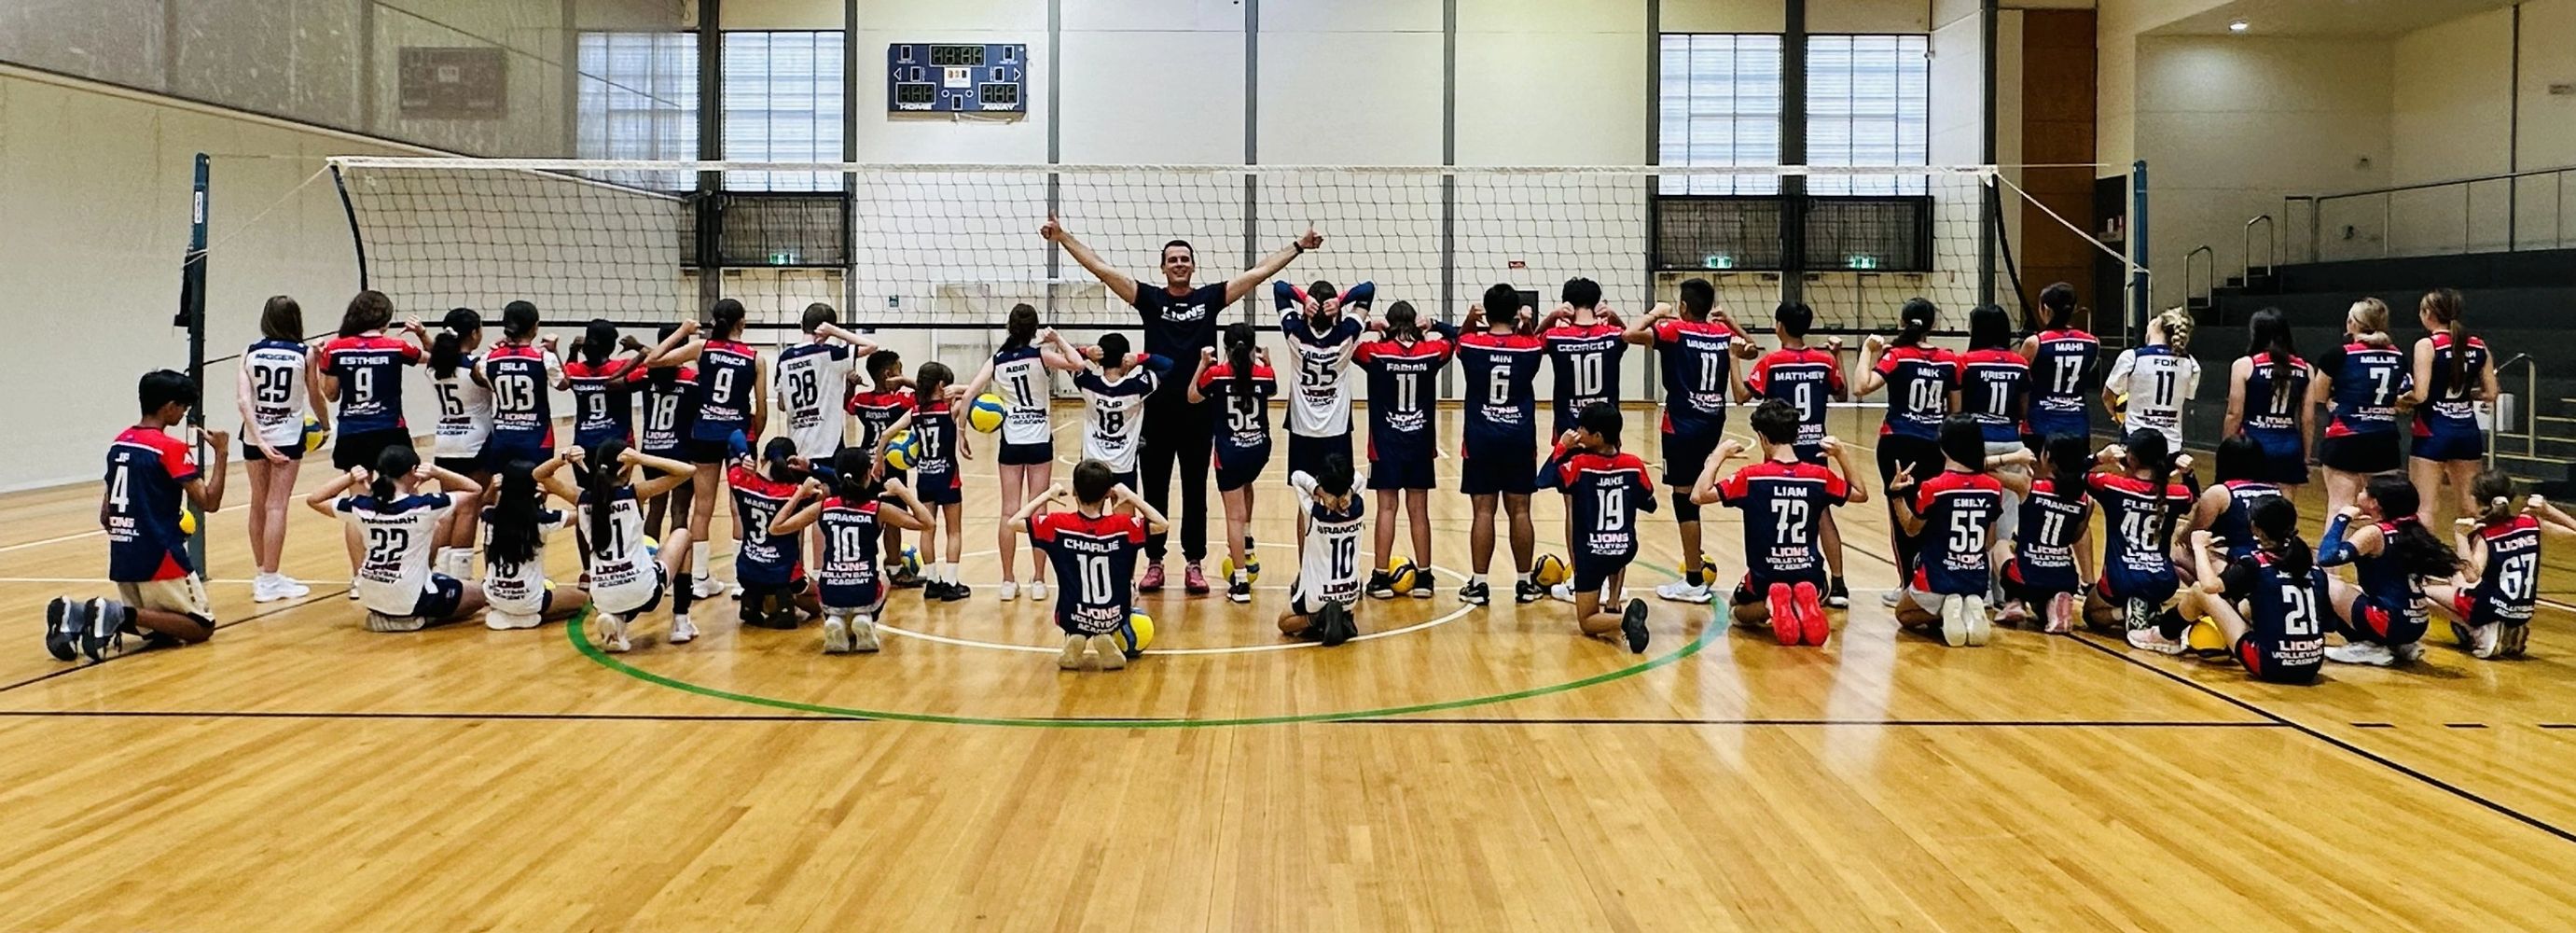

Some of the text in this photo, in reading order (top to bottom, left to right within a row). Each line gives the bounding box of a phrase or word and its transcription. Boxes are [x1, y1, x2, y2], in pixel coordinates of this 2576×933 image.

[1162, 303, 1206, 321] LIONS
[339, 356, 390, 365] ESTHER
[1489, 354, 1512, 363] MIN
[1557, 340, 1615, 353] GEORGE P
[2055, 342, 2084, 352] MAHI
[2154, 358, 2179, 367] FOX
[254, 365, 294, 403] 29
[499, 362, 528, 371] ISLA
[1005, 363, 1031, 374] ABBY
[1300, 355, 1339, 387] 55
[1571, 352, 1603, 397] 10
[1700, 352, 1718, 391] 11
[1774, 371, 1825, 381] MATTHEW
[1980, 369, 2021, 381] KRISTY
[2053, 355, 2084, 394] 17
[354, 367, 374, 403] 9
[435, 383, 464, 416] 15
[494, 375, 534, 411] 03
[712, 367, 735, 404] 9
[788, 369, 819, 411] 28
[1010, 374, 1034, 407] 11
[1395, 373, 1417, 411] 11
[1489, 365, 1511, 405] 6
[1794, 382, 1811, 422] 9
[1908, 378, 1945, 414] 04
[1988, 381, 2008, 416] 11
[2155, 369, 2176, 406] 11
[2369, 367, 2391, 406] 7
[589, 393, 607, 420] 9
[649, 393, 679, 430] 18
[1096, 397, 1123, 409] FILIP
[1227, 396, 1261, 431] 52
[1096, 407, 1125, 435] 18
[1797, 424, 1822, 434] ONS
[917, 425, 940, 458] 17
[110, 465, 130, 513] 4
[1596, 475, 1624, 487] JAKE
[1773, 485, 1807, 497] LIAM
[109, 516, 135, 529] ONS
[749, 508, 768, 544] 3
[823, 512, 873, 523] MIRANDA
[1597, 487, 1625, 532] 19
[1770, 498, 1809, 544] 72
[369, 528, 409, 563] 22
[596, 518, 625, 561] 1
[831, 524, 861, 563] 10
[1063, 538, 1120, 552] CHARLIE
[1589, 533, 1629, 543] LIONS
[1948, 509, 1987, 553] 55
[2040, 510, 2066, 546] 11
[2120, 510, 2166, 551] 48
[2494, 534, 2538, 553] LIONS
[826, 561, 870, 572] LIONS
[1330, 535, 1357, 580] 10
[1770, 546, 1809, 557] LIONS
[1076, 553, 1113, 605] 10
[2499, 552, 2537, 601] 67
[1076, 603, 1122, 620] LIONS
[2281, 584, 2319, 635] 21
[2278, 637, 2323, 651] LIONS
